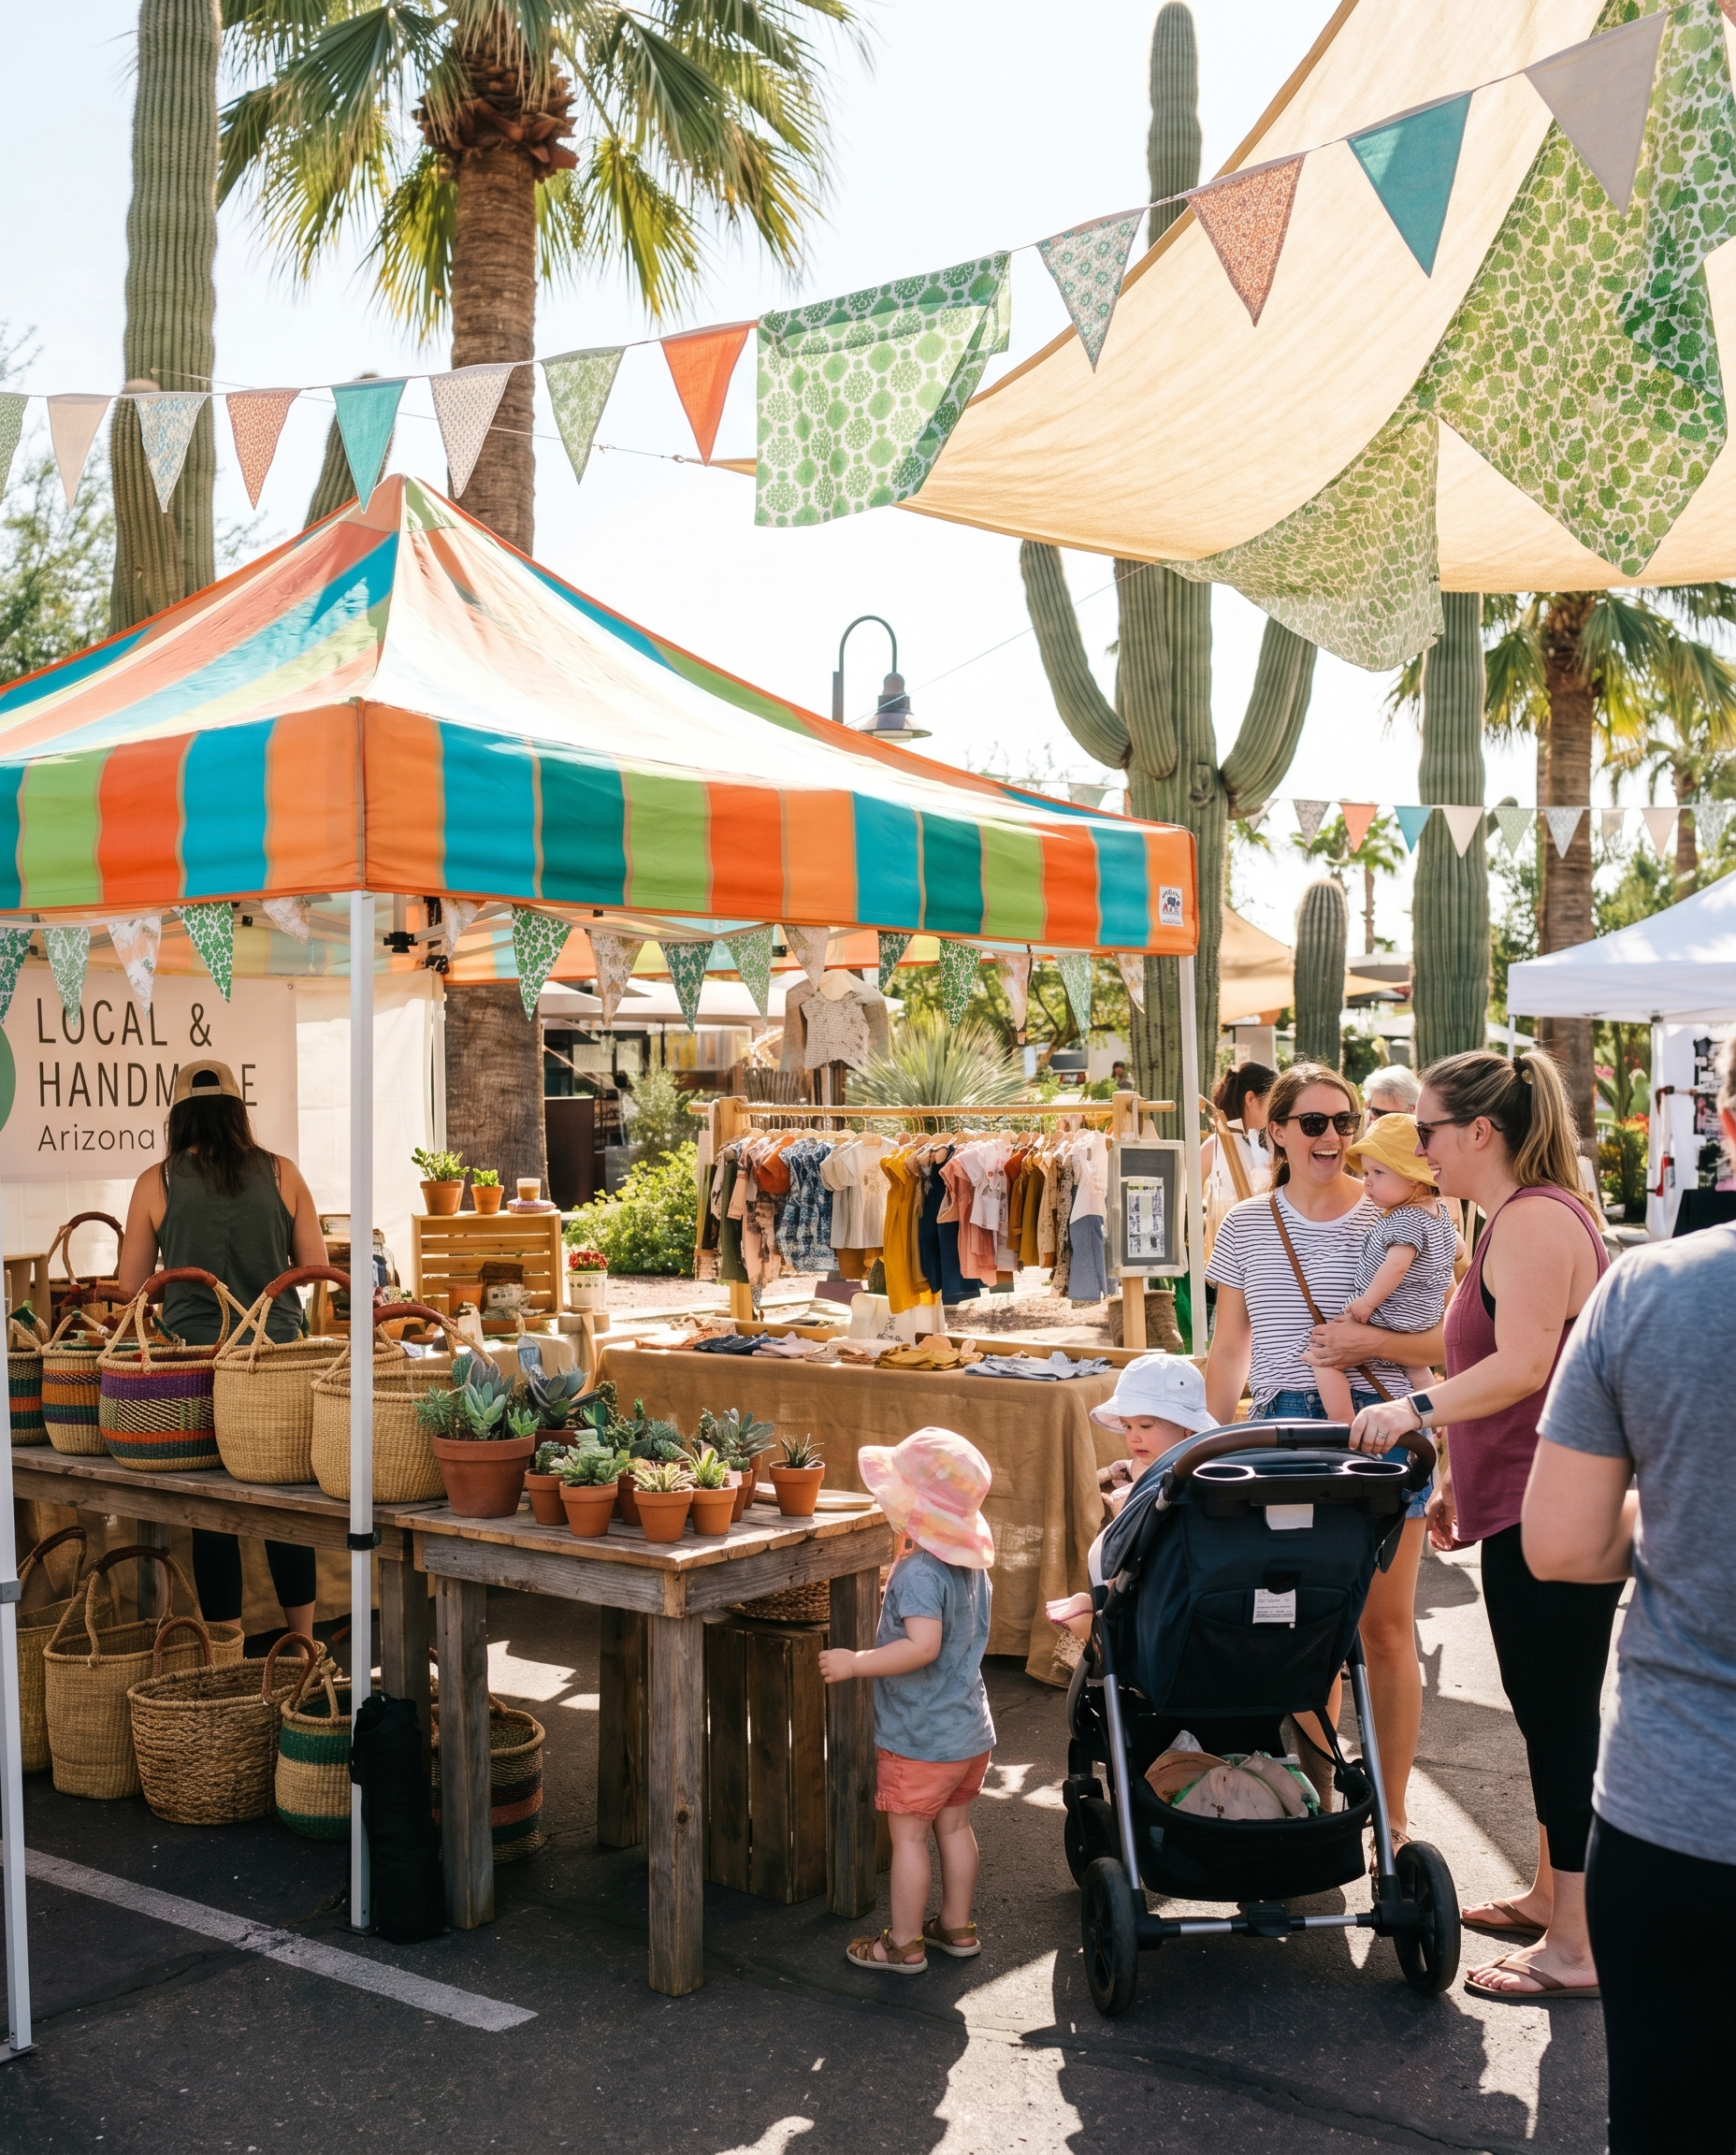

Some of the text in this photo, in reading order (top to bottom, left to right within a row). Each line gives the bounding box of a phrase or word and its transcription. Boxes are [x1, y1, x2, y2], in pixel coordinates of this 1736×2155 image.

[36, 997, 212, 1047] LOCAL &
[38, 1062, 258, 1107] HANDME
[37, 1123, 155, 1151] Arizona
